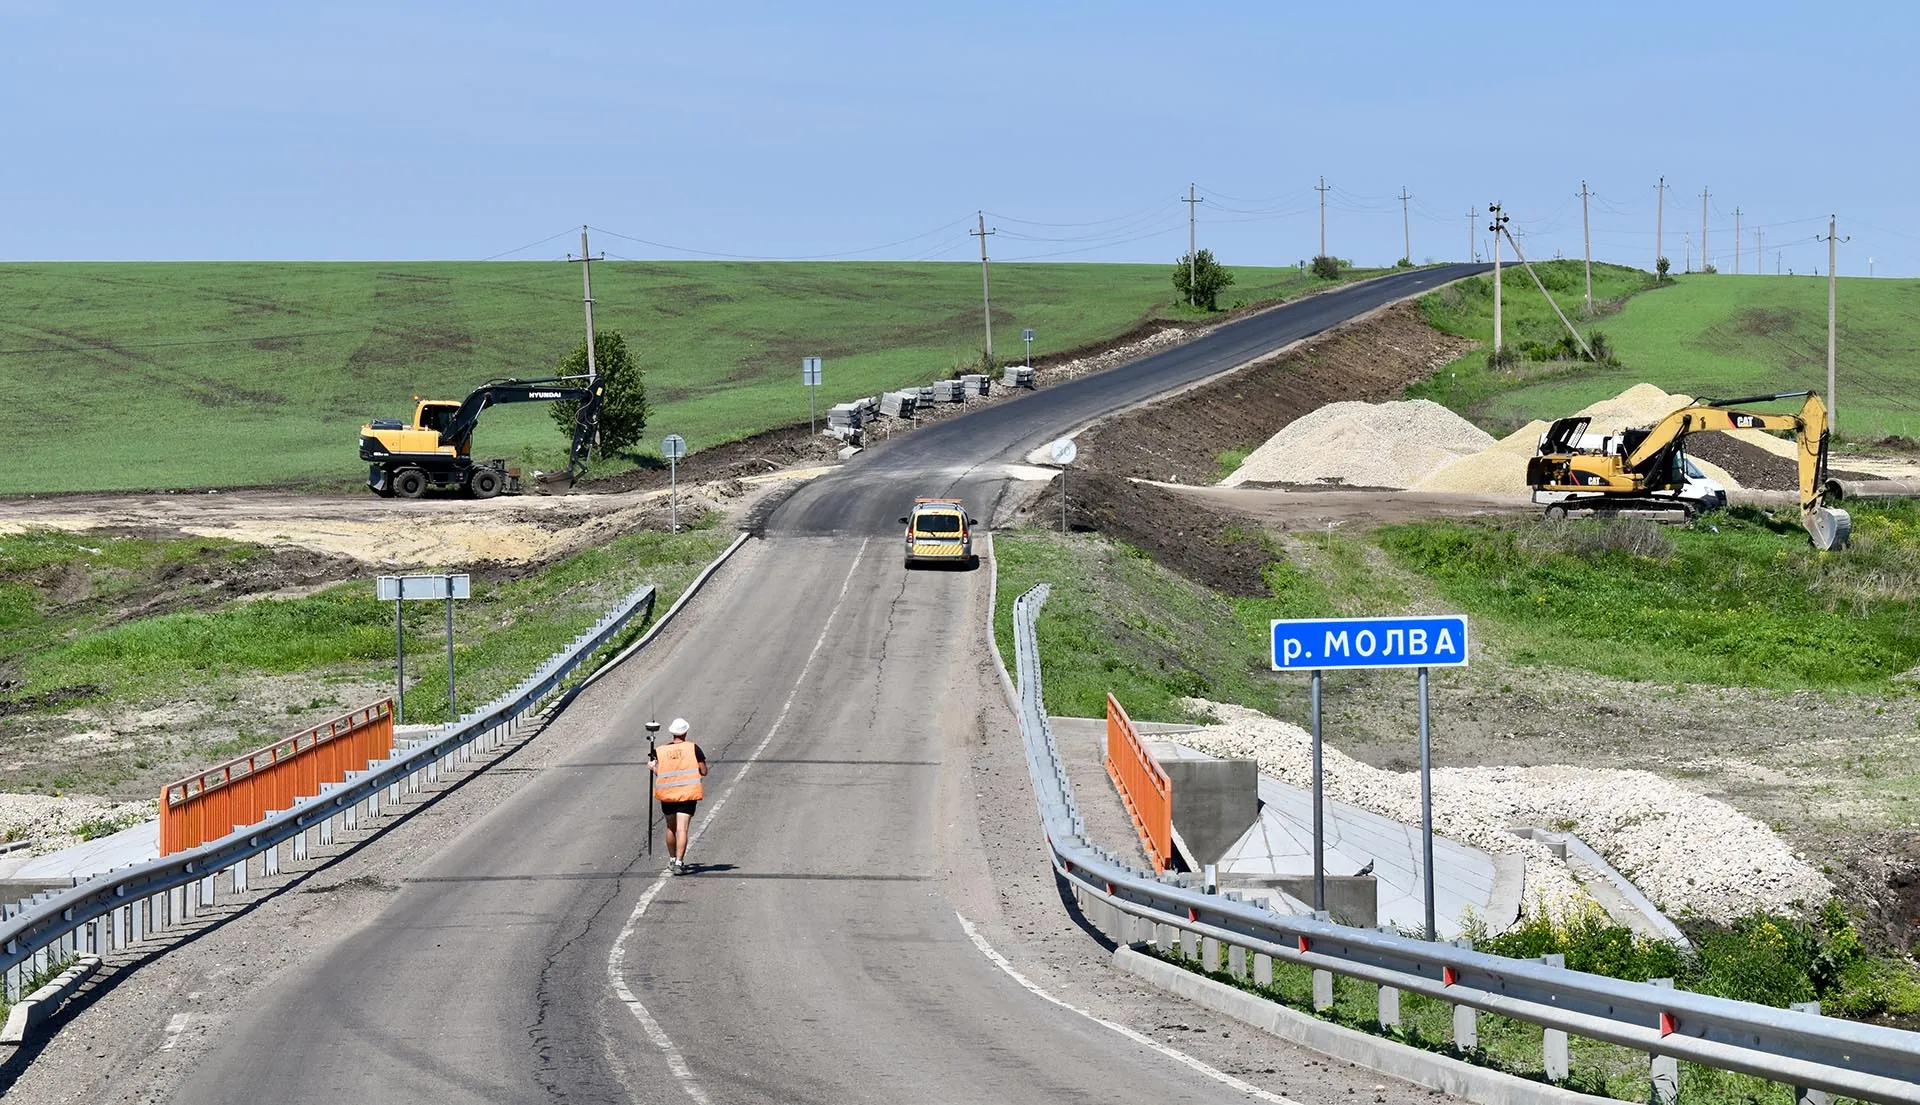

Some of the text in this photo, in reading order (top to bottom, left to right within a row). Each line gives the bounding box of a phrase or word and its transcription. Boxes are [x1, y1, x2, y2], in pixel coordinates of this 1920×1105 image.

[1736, 416, 1753, 428] CAT
[1587, 476, 1601, 486] CAT
[1283, 627, 1456, 666] р. МОЛВА
